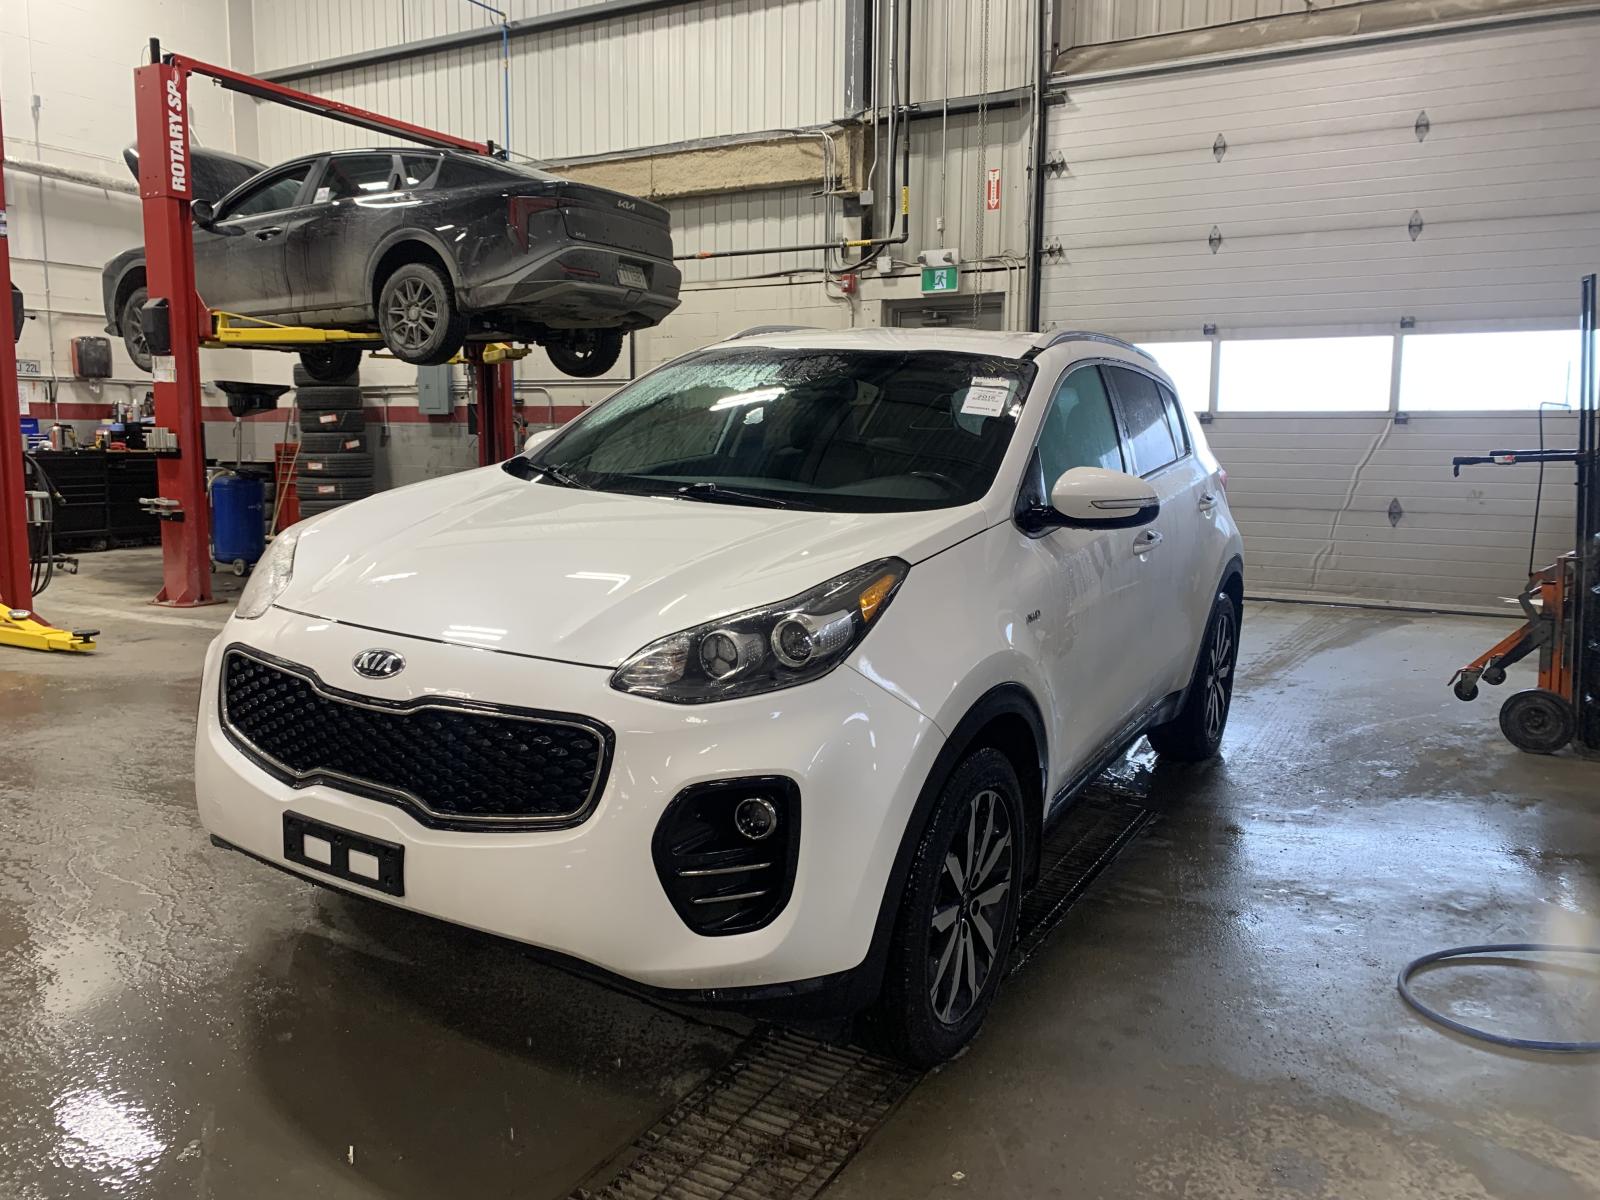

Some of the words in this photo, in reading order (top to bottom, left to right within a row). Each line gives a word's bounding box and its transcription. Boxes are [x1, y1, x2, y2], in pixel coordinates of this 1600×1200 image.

[168, 110, 186, 192] ROTARY
[617, 200, 636, 210] KIA
[356, 652, 398, 673] KIA
